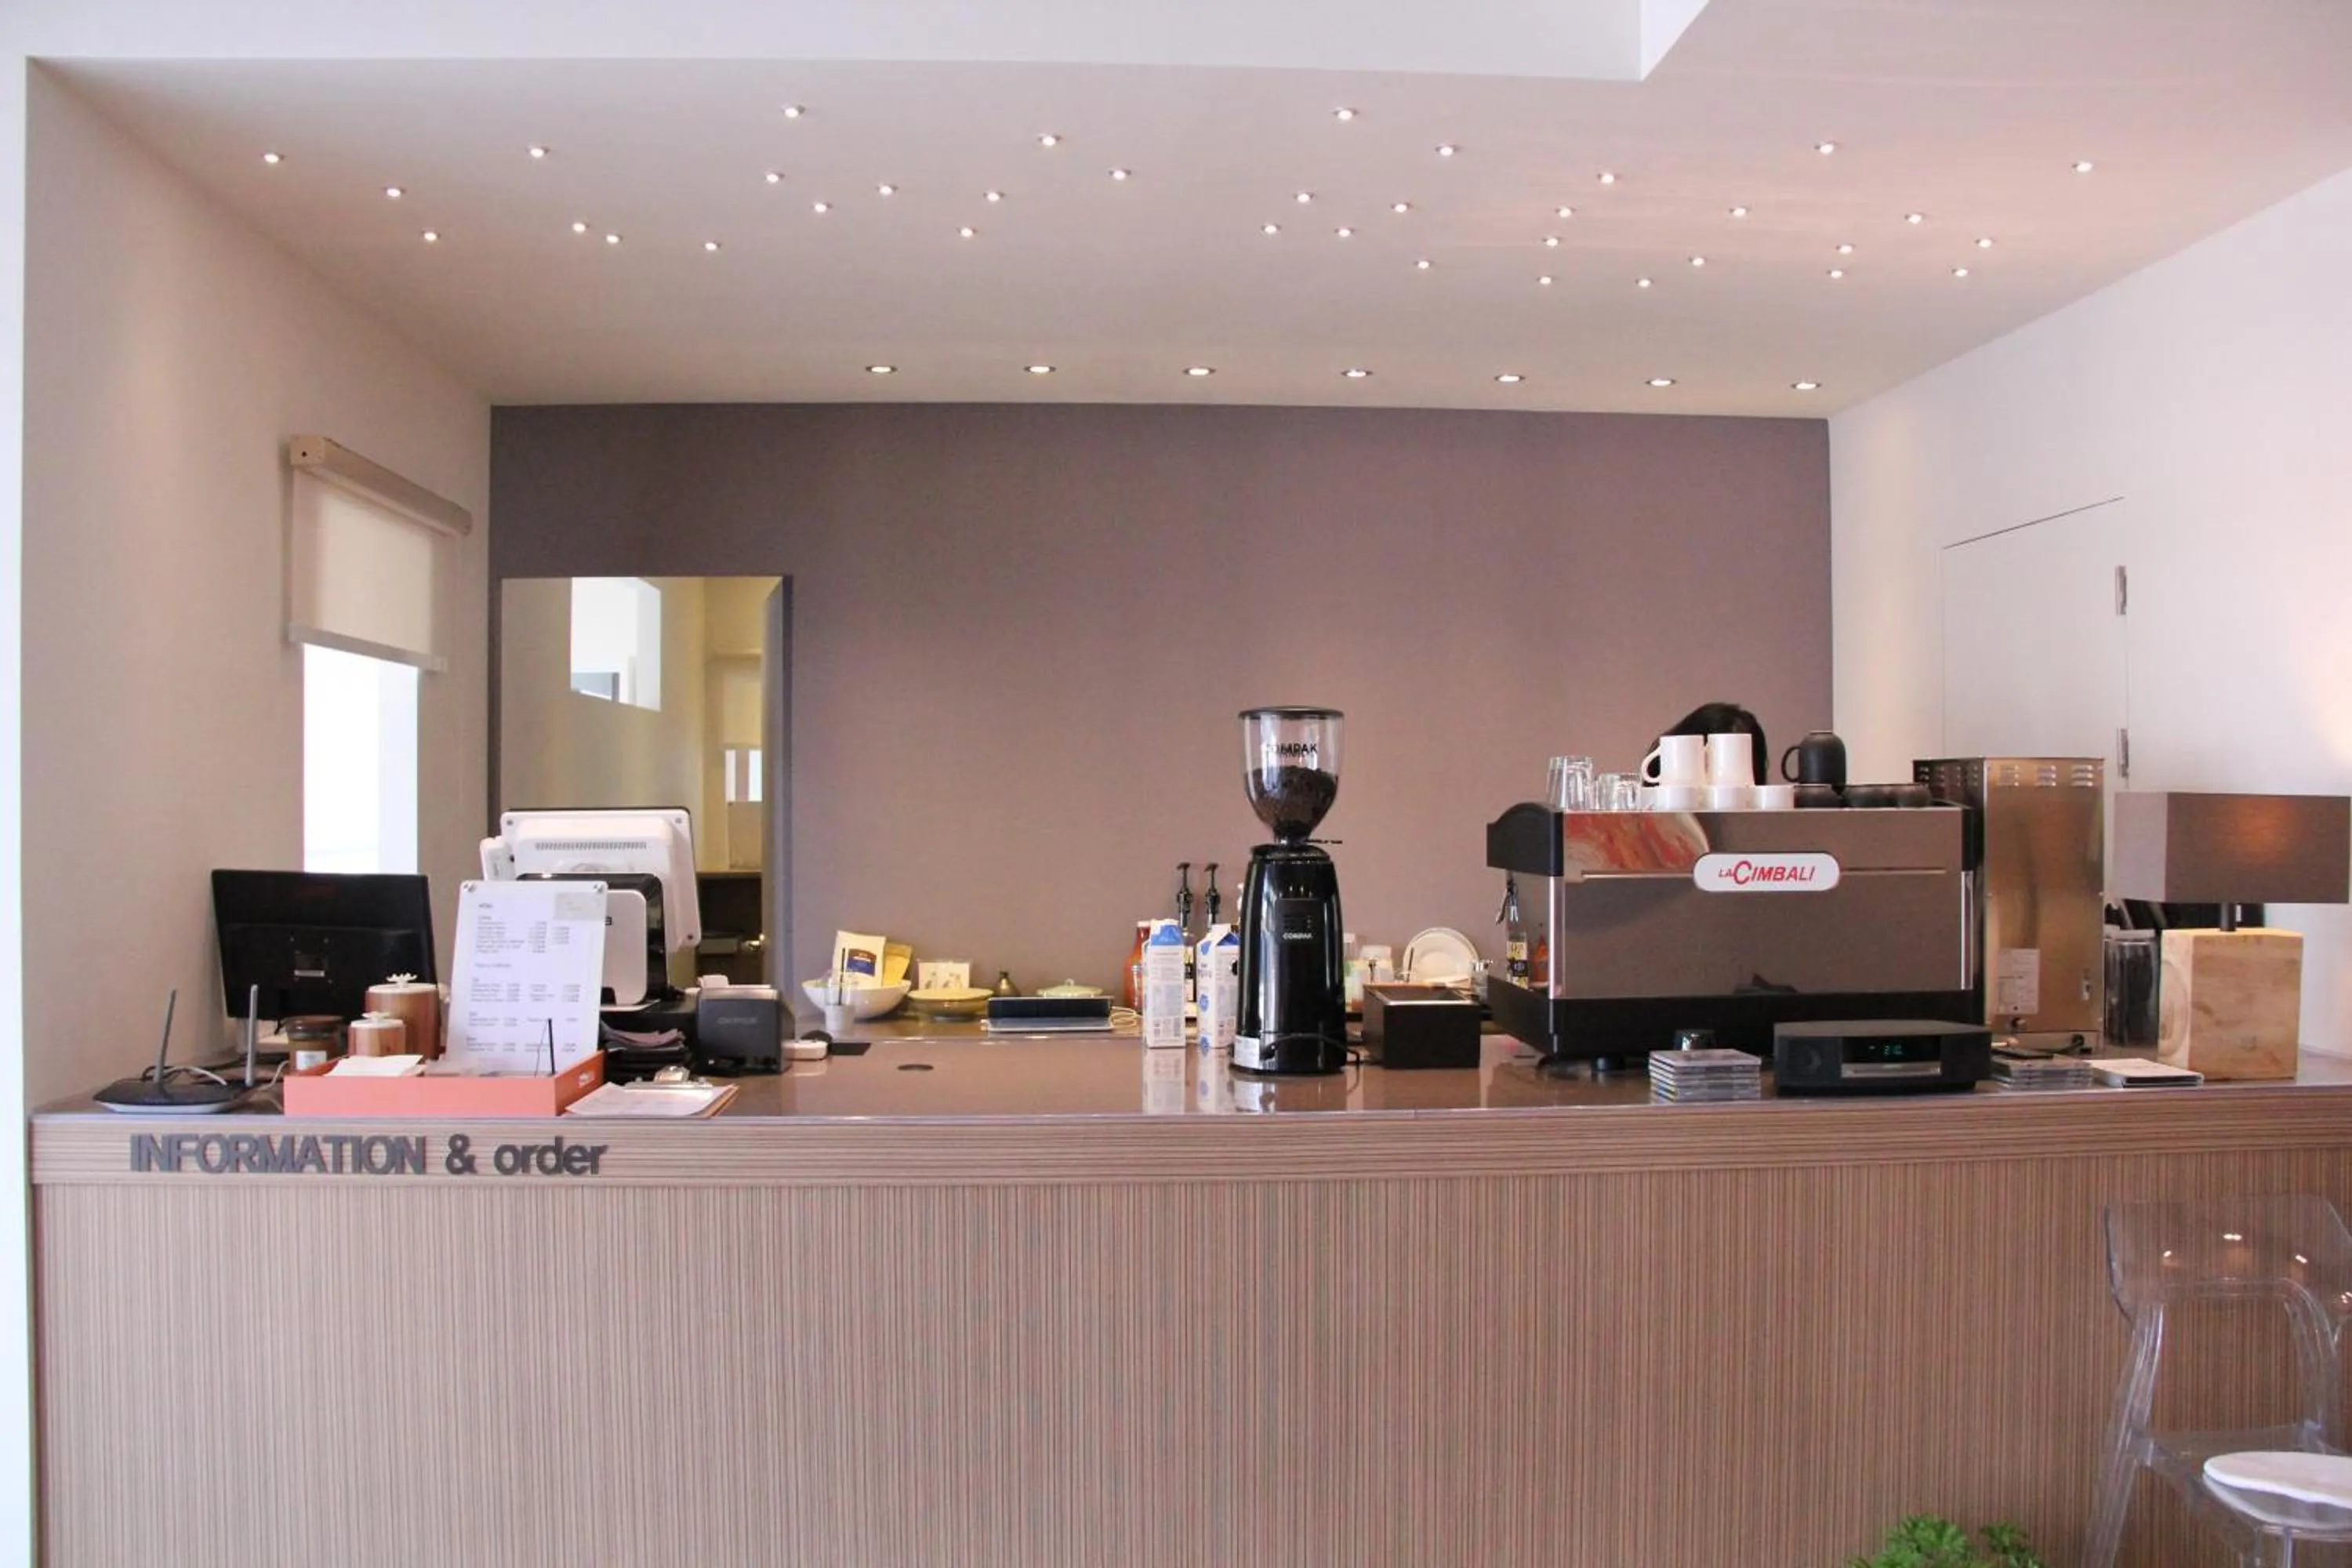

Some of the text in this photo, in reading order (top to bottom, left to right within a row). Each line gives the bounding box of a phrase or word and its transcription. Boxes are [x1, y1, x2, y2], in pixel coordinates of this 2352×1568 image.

[1266, 742, 1318, 754] OMPAK
[1719, 860, 1816, 885] LA CIMBALI
[129, 1133, 608, 1175] INFORMATION & order
